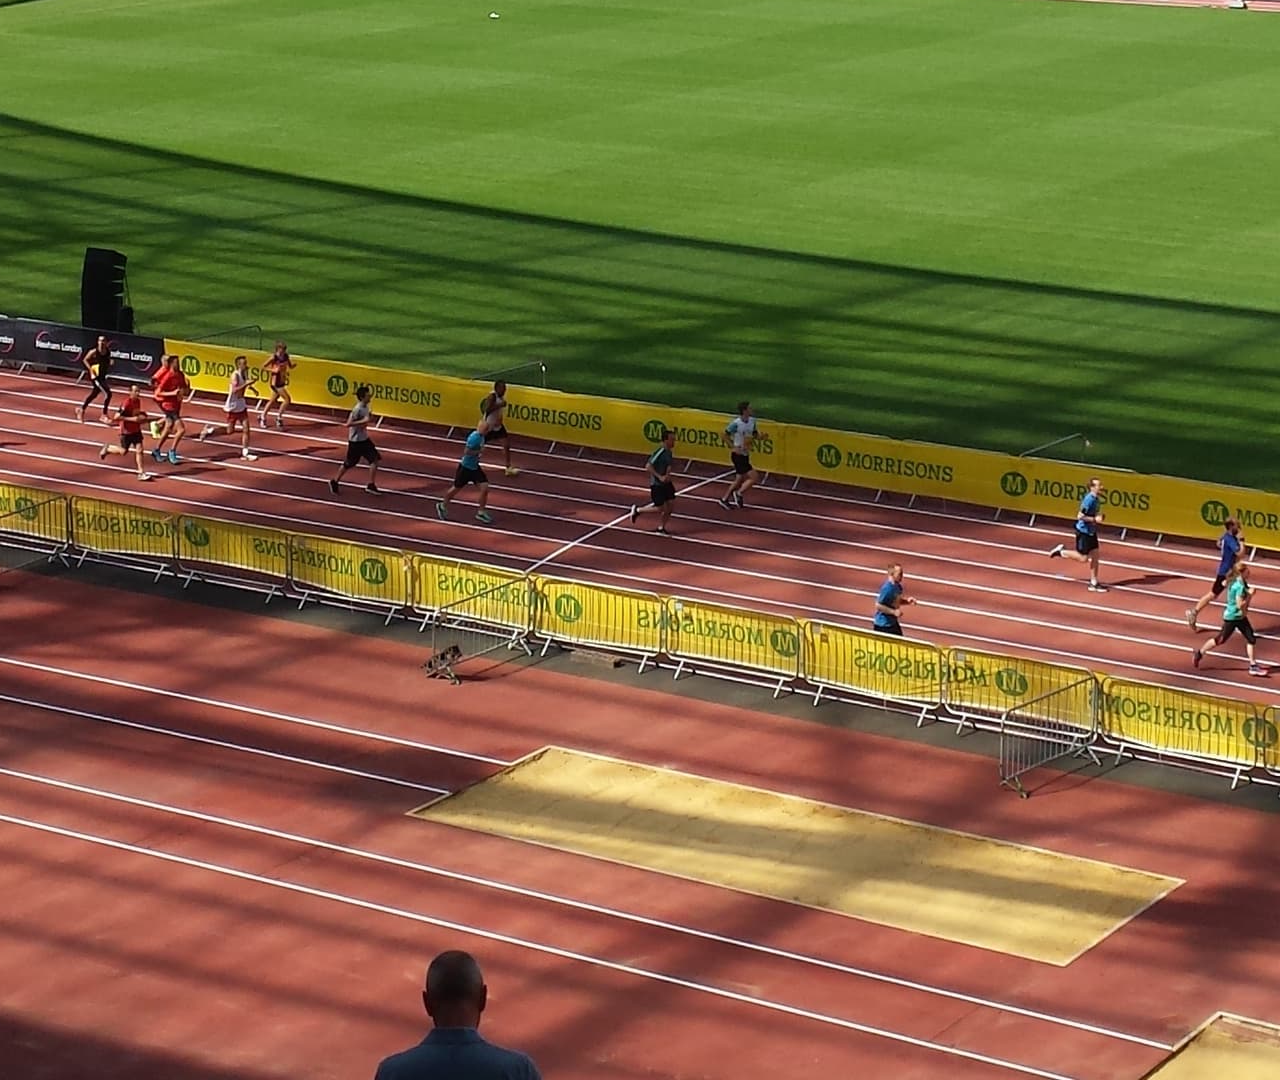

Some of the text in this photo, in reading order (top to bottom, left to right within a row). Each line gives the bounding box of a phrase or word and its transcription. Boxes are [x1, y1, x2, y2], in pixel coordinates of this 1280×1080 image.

[36, 340, 82, 353] Newham London
[131, 352, 153, 362] London
[507, 404, 602, 431] MORRISONS
[846, 452, 953, 482] MORRISONS
